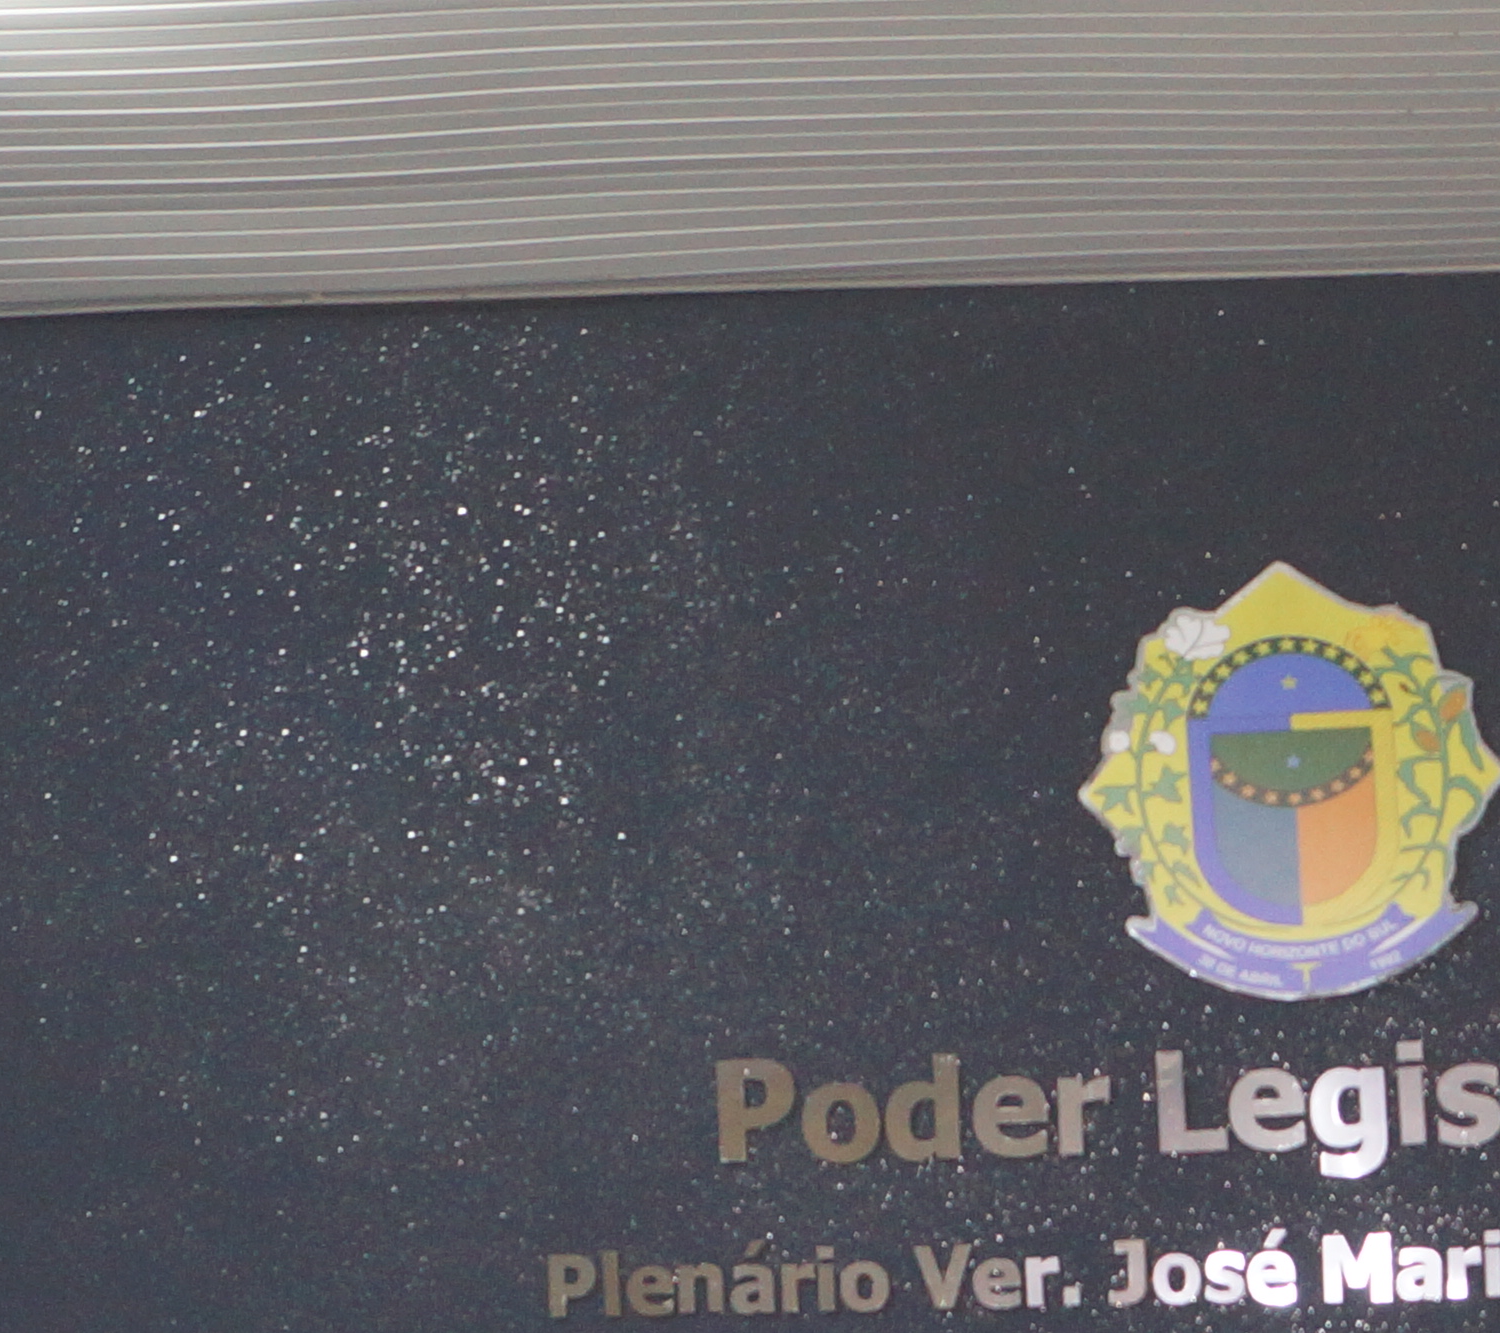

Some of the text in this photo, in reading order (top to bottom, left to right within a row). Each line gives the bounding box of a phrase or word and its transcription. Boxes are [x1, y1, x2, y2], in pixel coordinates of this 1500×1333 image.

[715, 1053, 1111, 1163] Poder
[546, 1239, 891, 1318] Plenário
[913, 1242, 1082, 1309] Ver.
[1108, 1228, 1299, 1309] José
